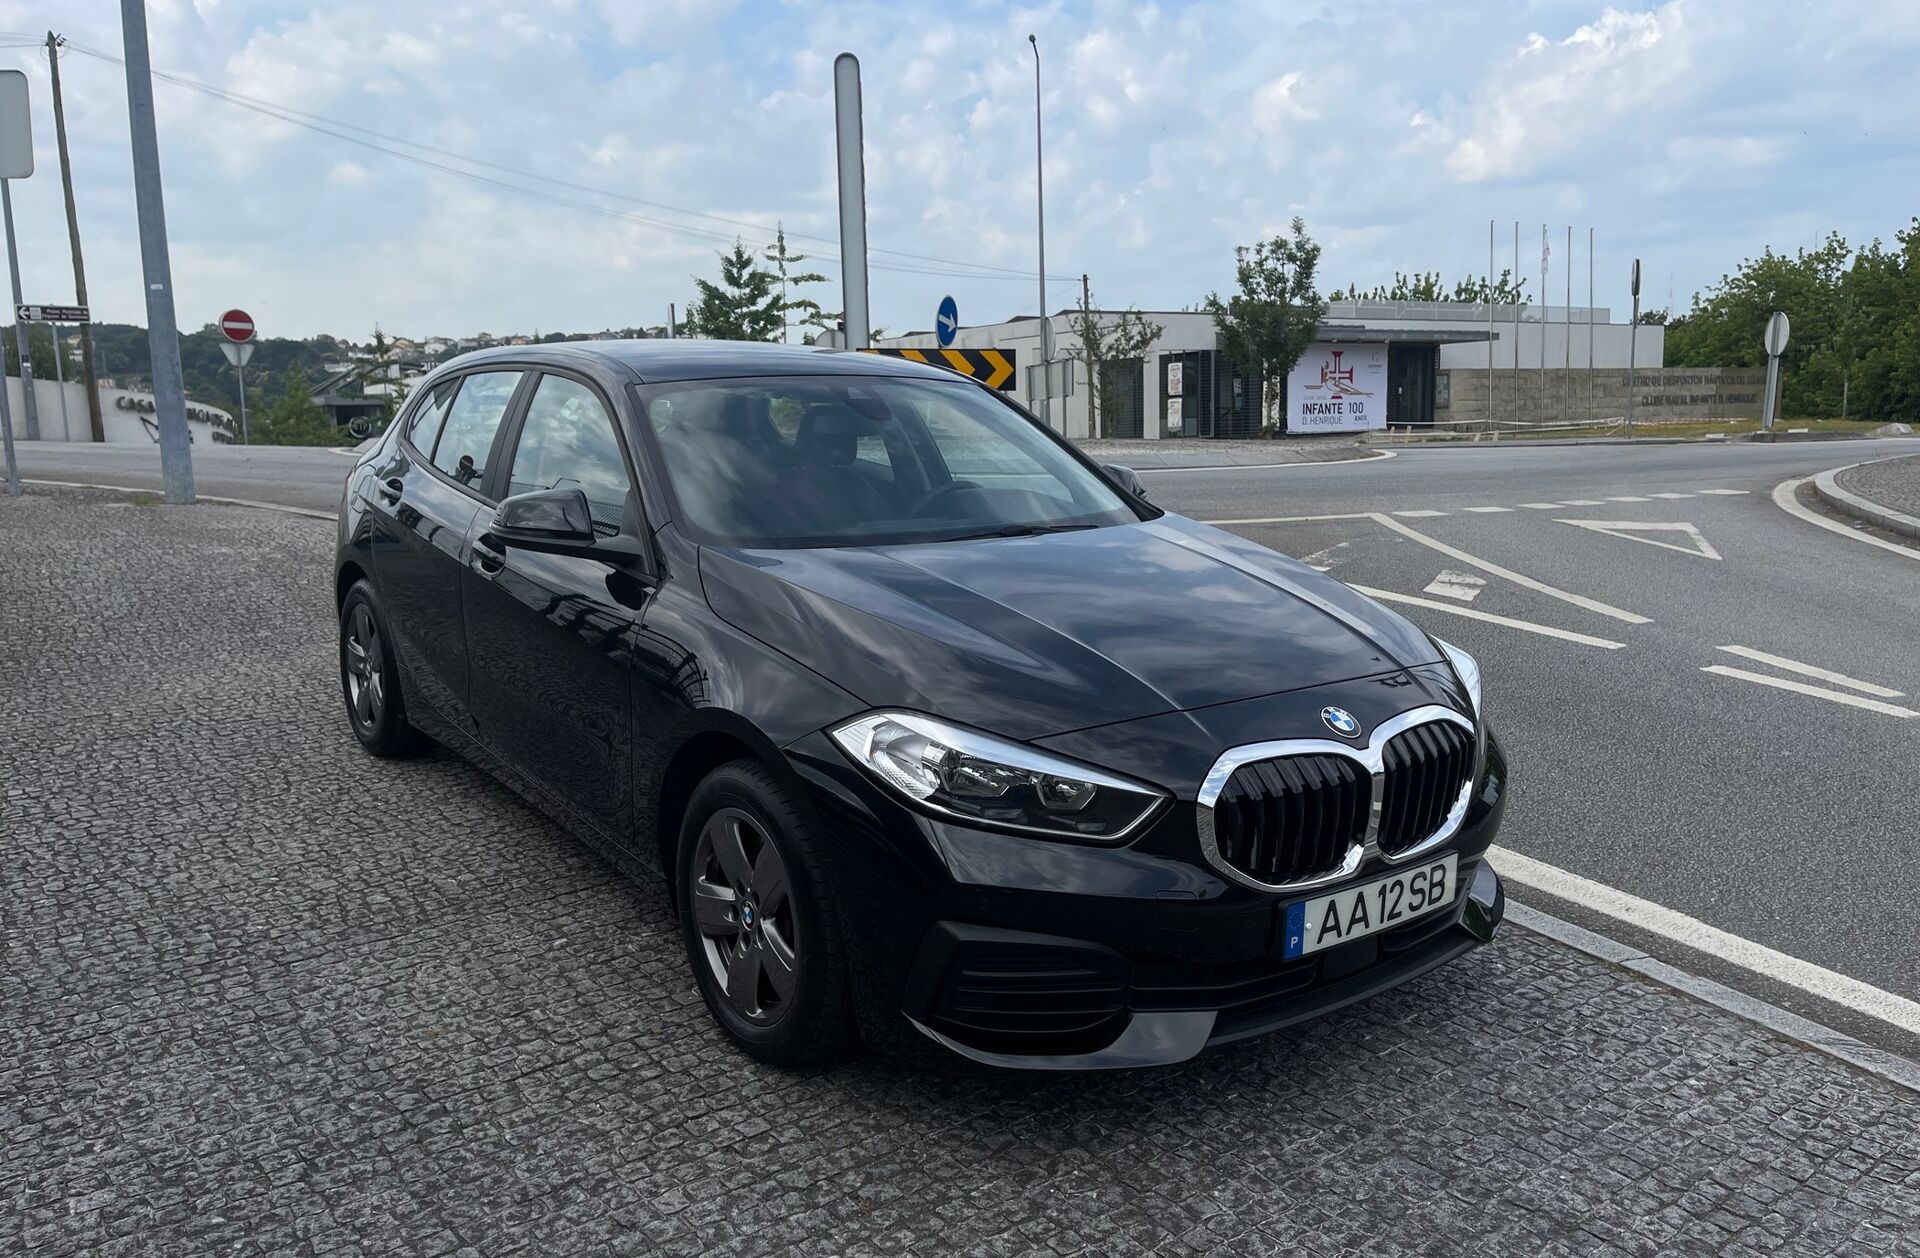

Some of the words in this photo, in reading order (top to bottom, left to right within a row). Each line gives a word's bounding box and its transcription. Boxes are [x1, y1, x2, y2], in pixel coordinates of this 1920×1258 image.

[115, 396, 156, 413] CASA
[1302, 402, 1344, 415] INFANTE
[1349, 401, 1364, 414] 100
[1302, 416, 1310, 425] D.
[1310, 415, 1343, 425] HENRIQUE
[1290, 936, 1299, 949] P
